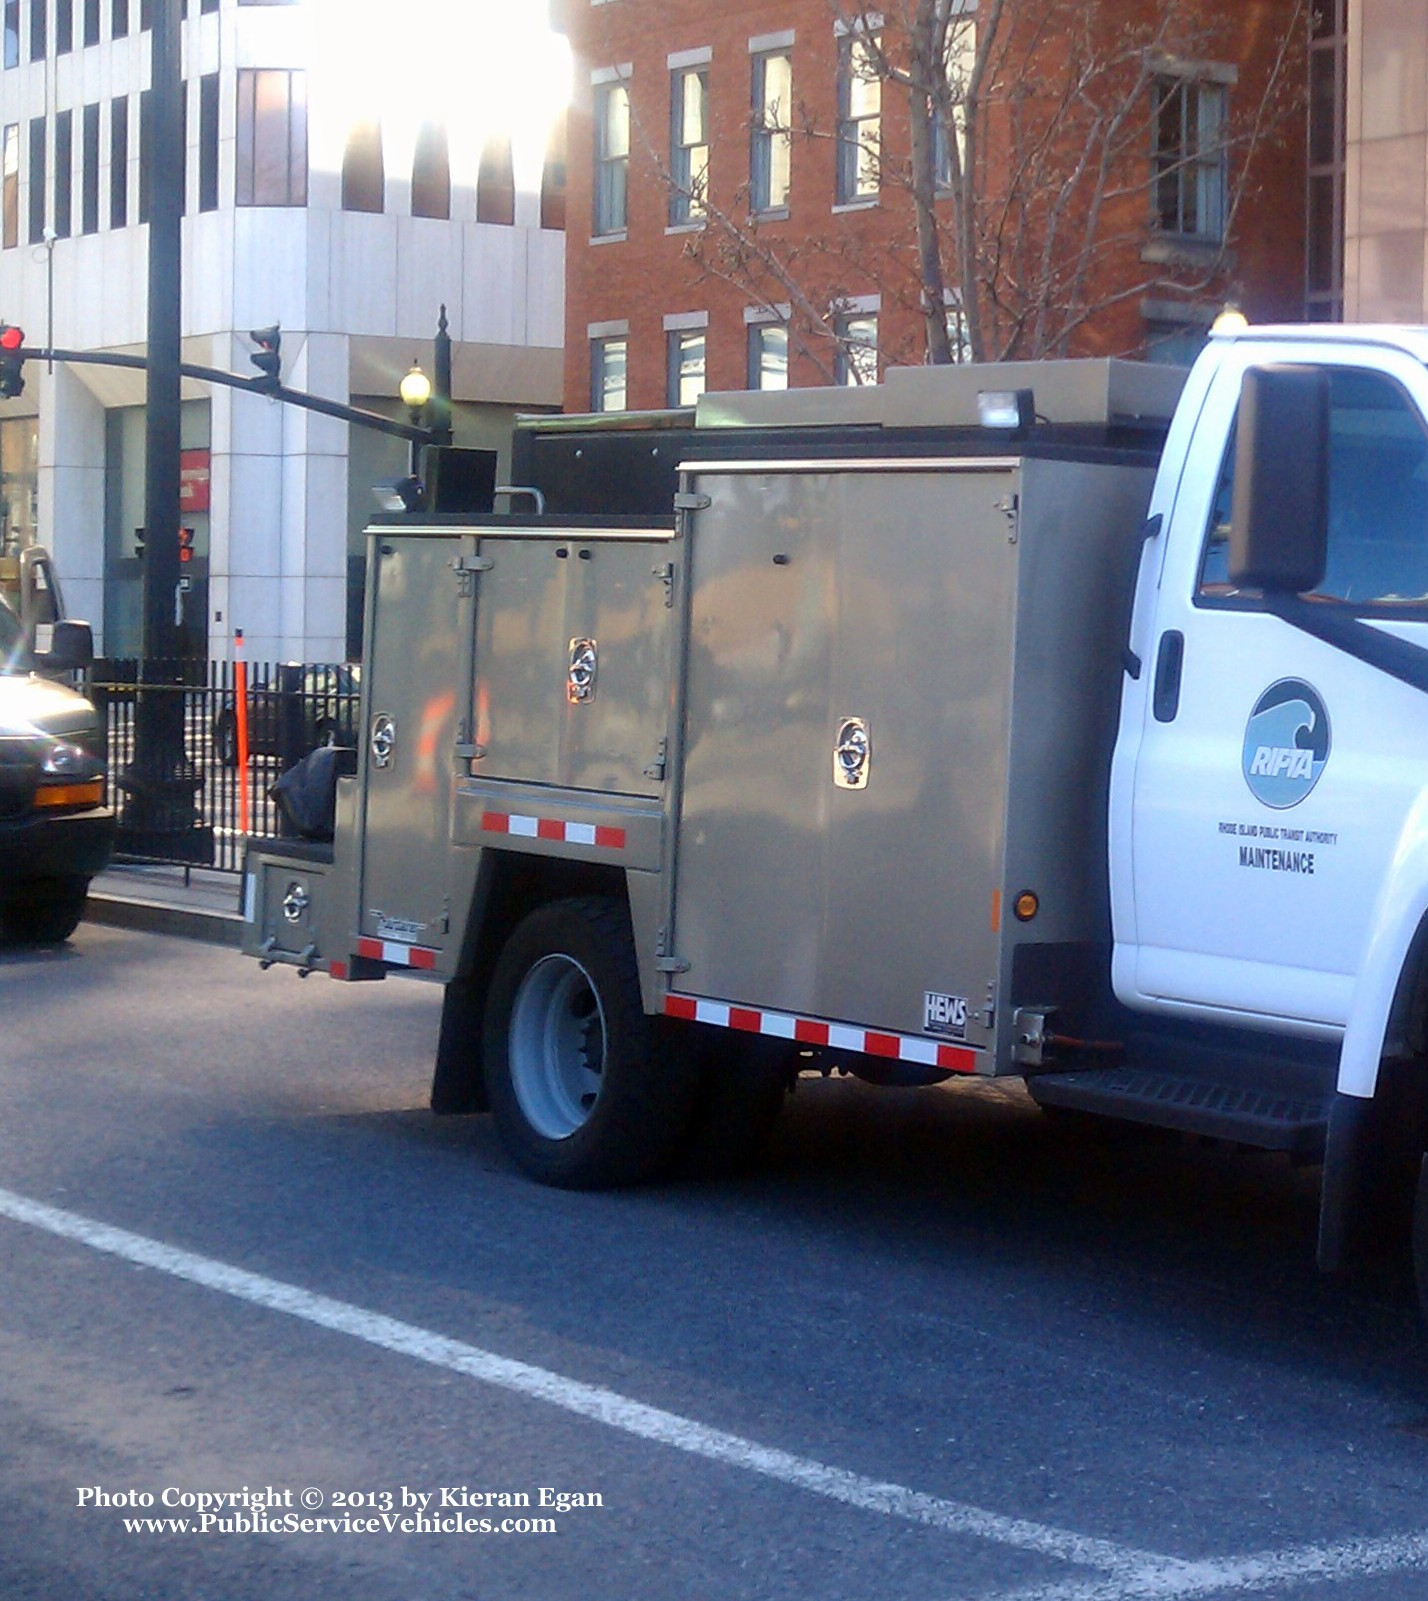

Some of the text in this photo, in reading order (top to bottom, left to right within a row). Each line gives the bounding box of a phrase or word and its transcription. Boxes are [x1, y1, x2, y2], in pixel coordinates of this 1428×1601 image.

[1249, 746, 1314, 780] RIPTA
[1239, 824, 1257, 837] ISLAND
[1259, 826, 1279, 839] PUBLIC
[1280, 828, 1304, 841] TRANSIT
[1239, 846, 1314, 874] MAINTENANCE
[925, 993, 966, 1027] HEWS
